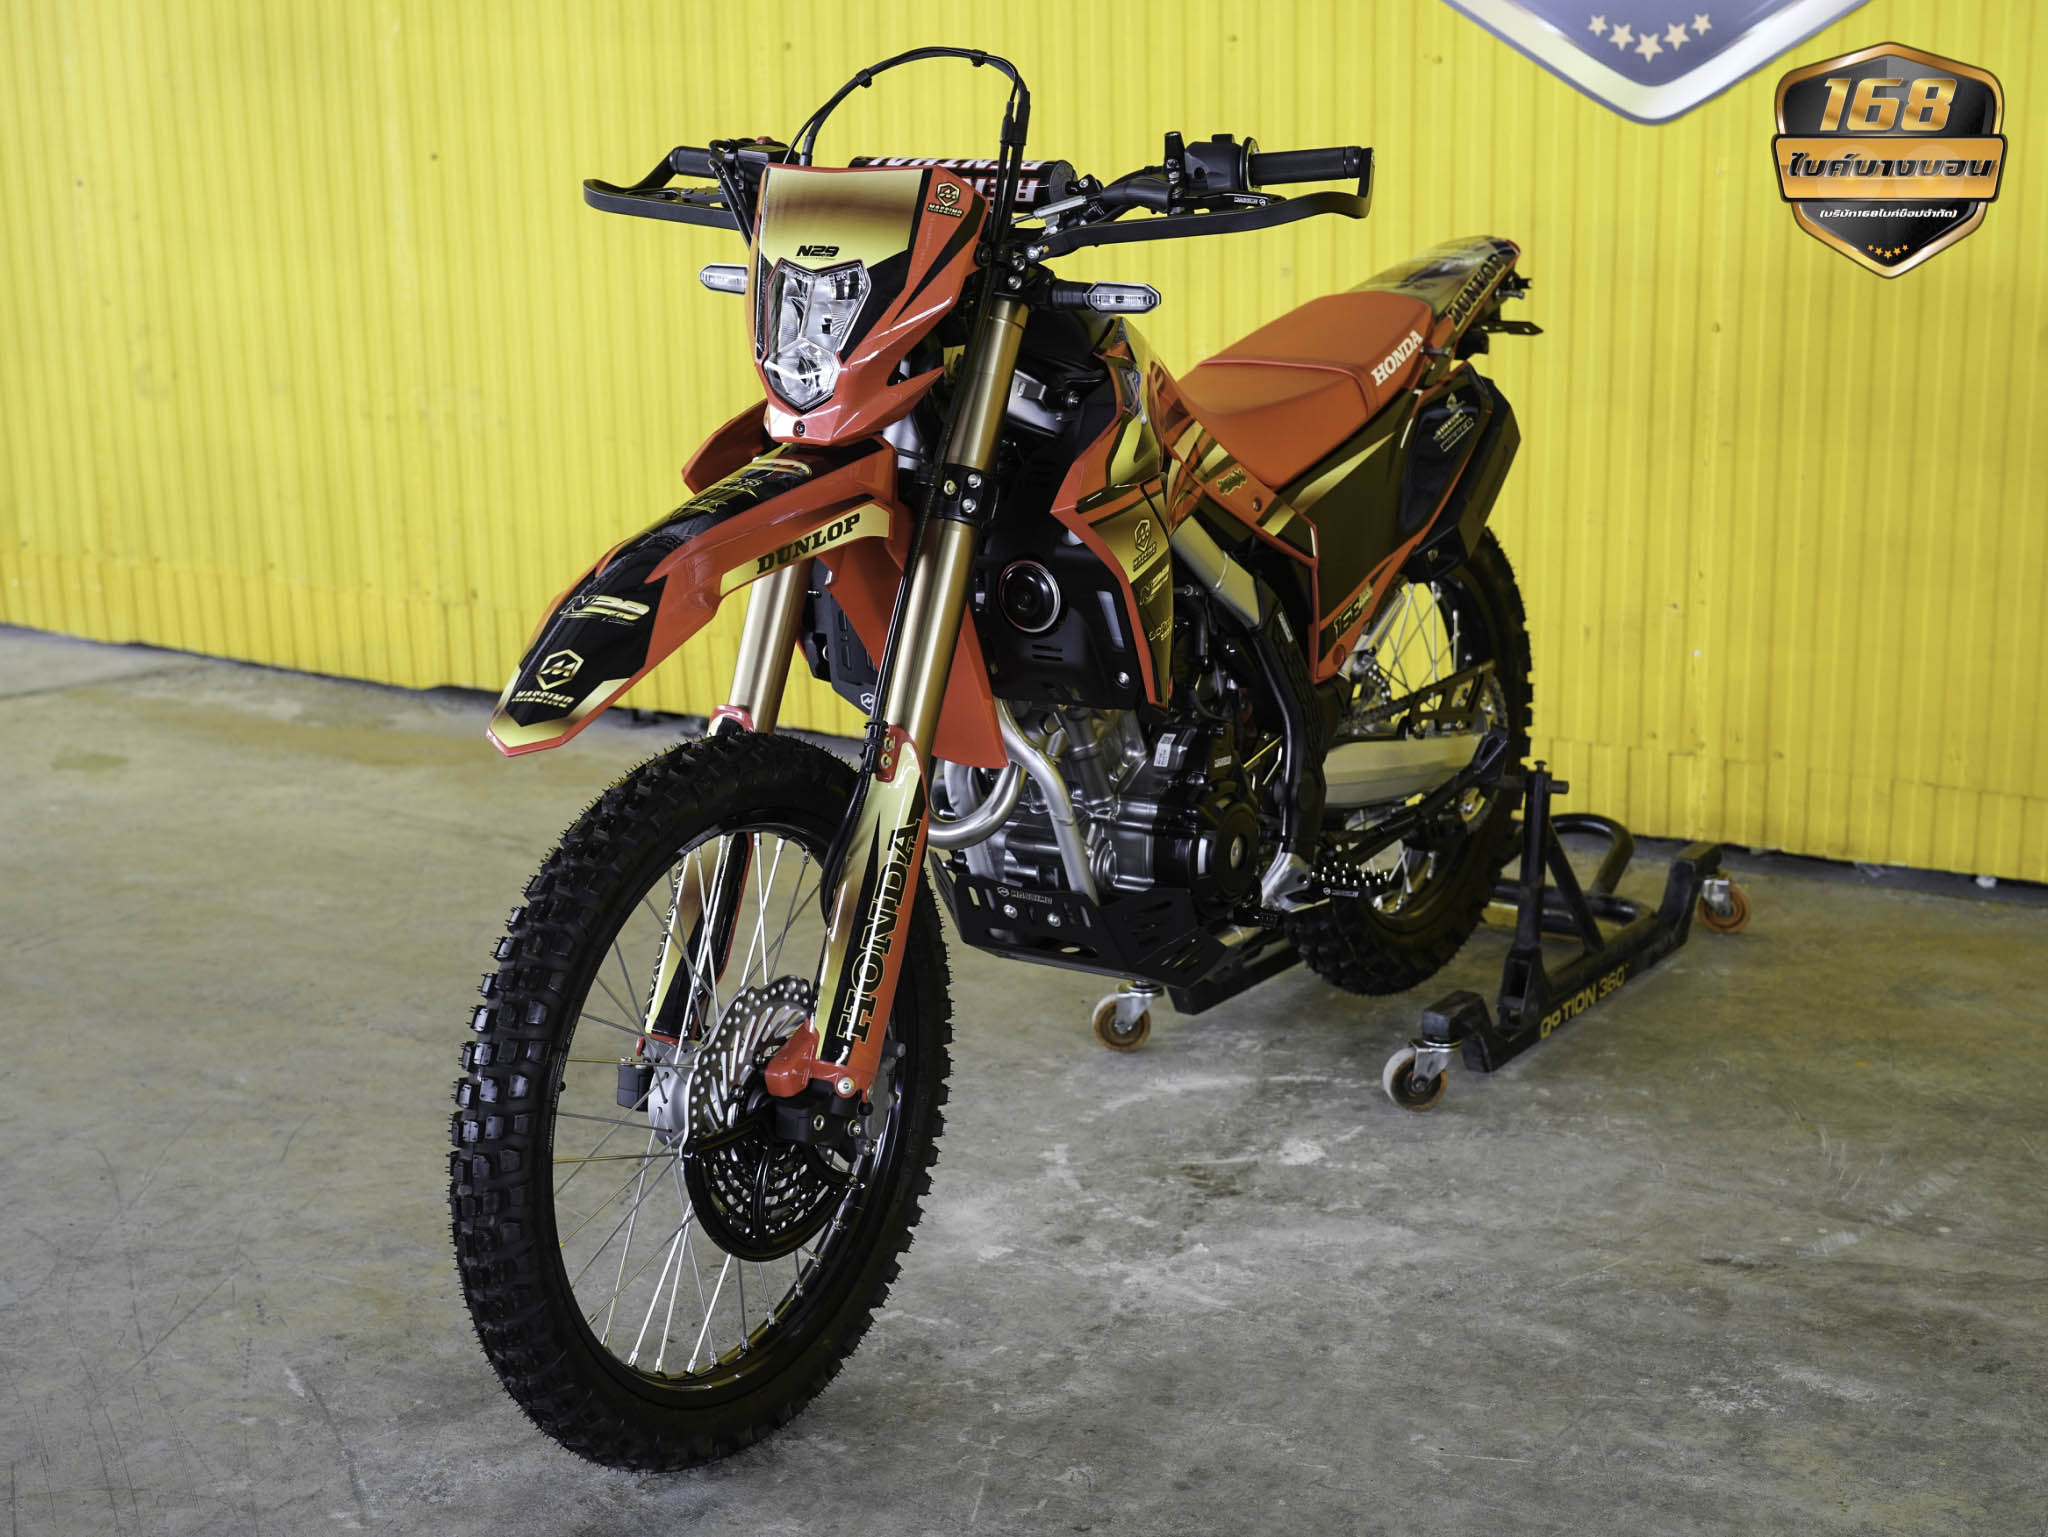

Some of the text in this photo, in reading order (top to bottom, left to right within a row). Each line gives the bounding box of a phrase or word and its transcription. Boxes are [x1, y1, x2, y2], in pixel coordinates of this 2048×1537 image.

[796, 245, 840, 257] N29
[1371, 330, 1423, 386] HONDA
[756, 513, 860, 574] DUNLOP
[511, 690, 574, 708] MASSIMO
[836, 819, 922, 1043] HONDA
